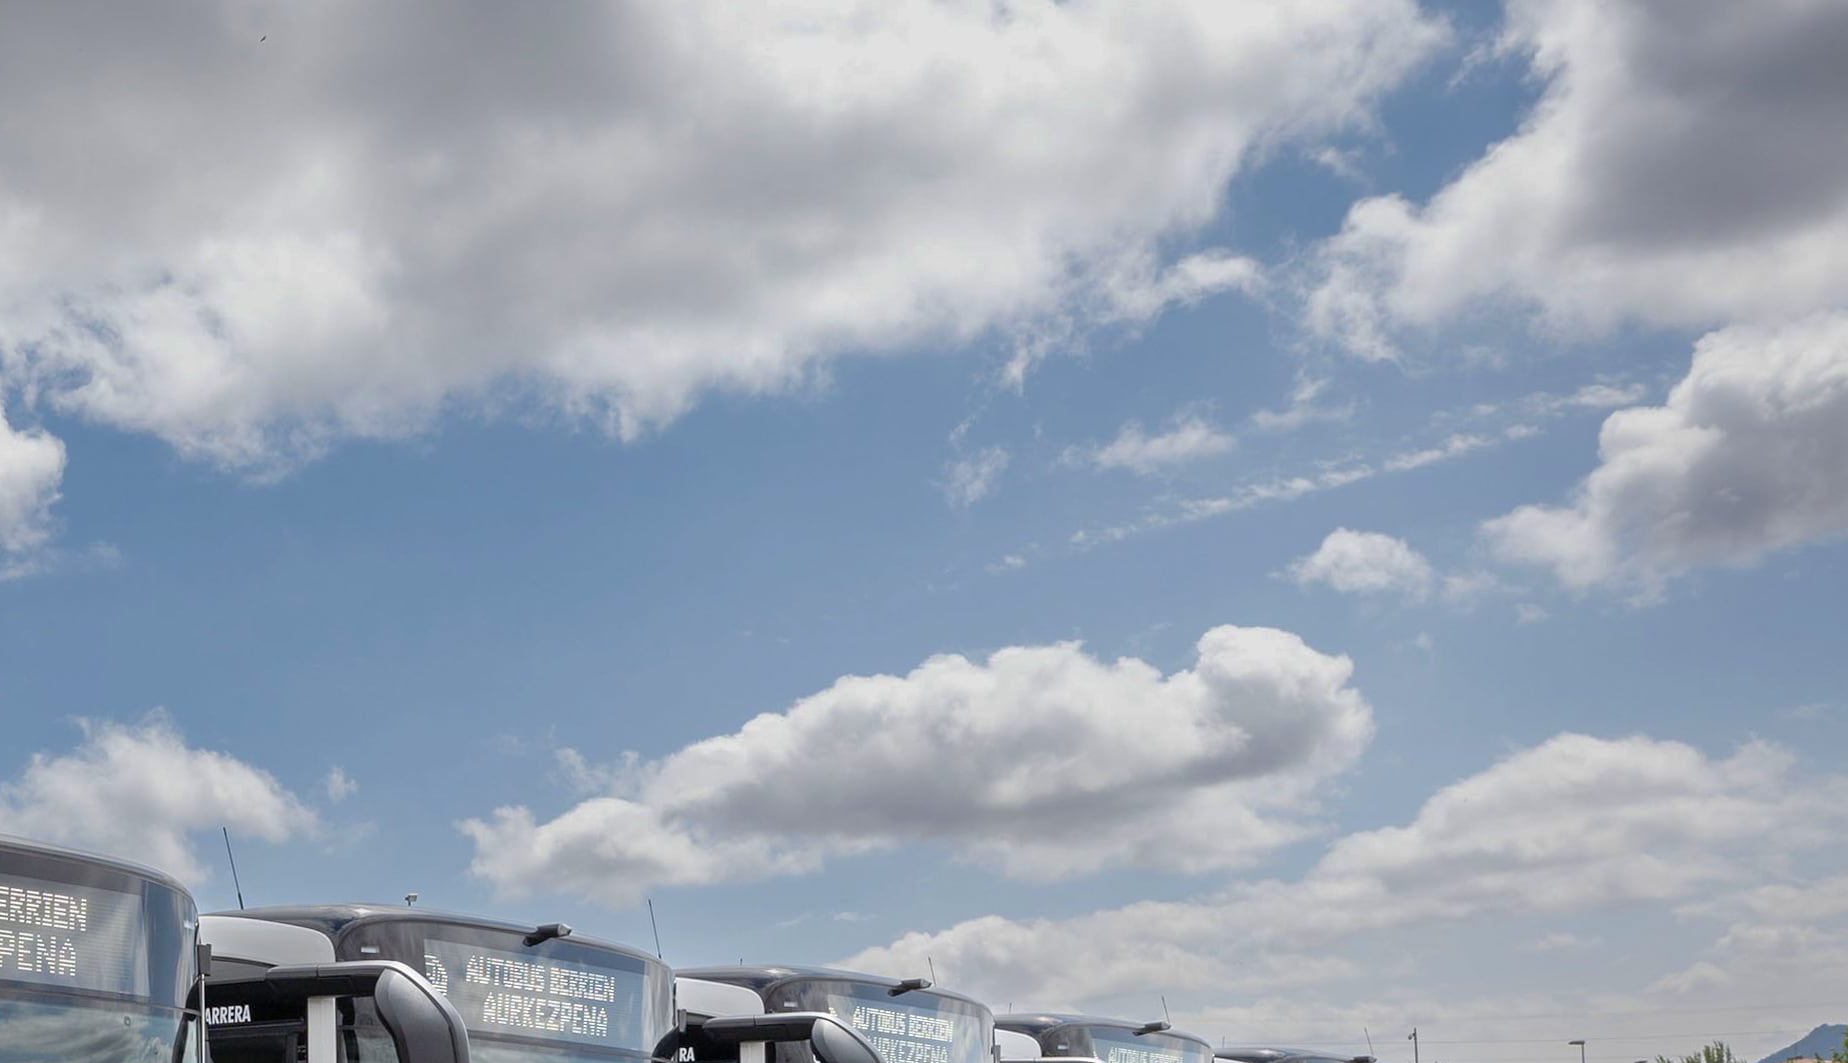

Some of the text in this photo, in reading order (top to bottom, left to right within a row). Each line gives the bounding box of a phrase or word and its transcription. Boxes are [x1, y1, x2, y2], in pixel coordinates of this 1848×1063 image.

[466, 955, 615, 1002] AUTOBUS BERRIEN
[205, 1004, 252, 1025] ARRERA
[483, 992, 609, 1037] AURKEZPENA
[853, 1006, 953, 1042] AUTOBUS BERRIEN
